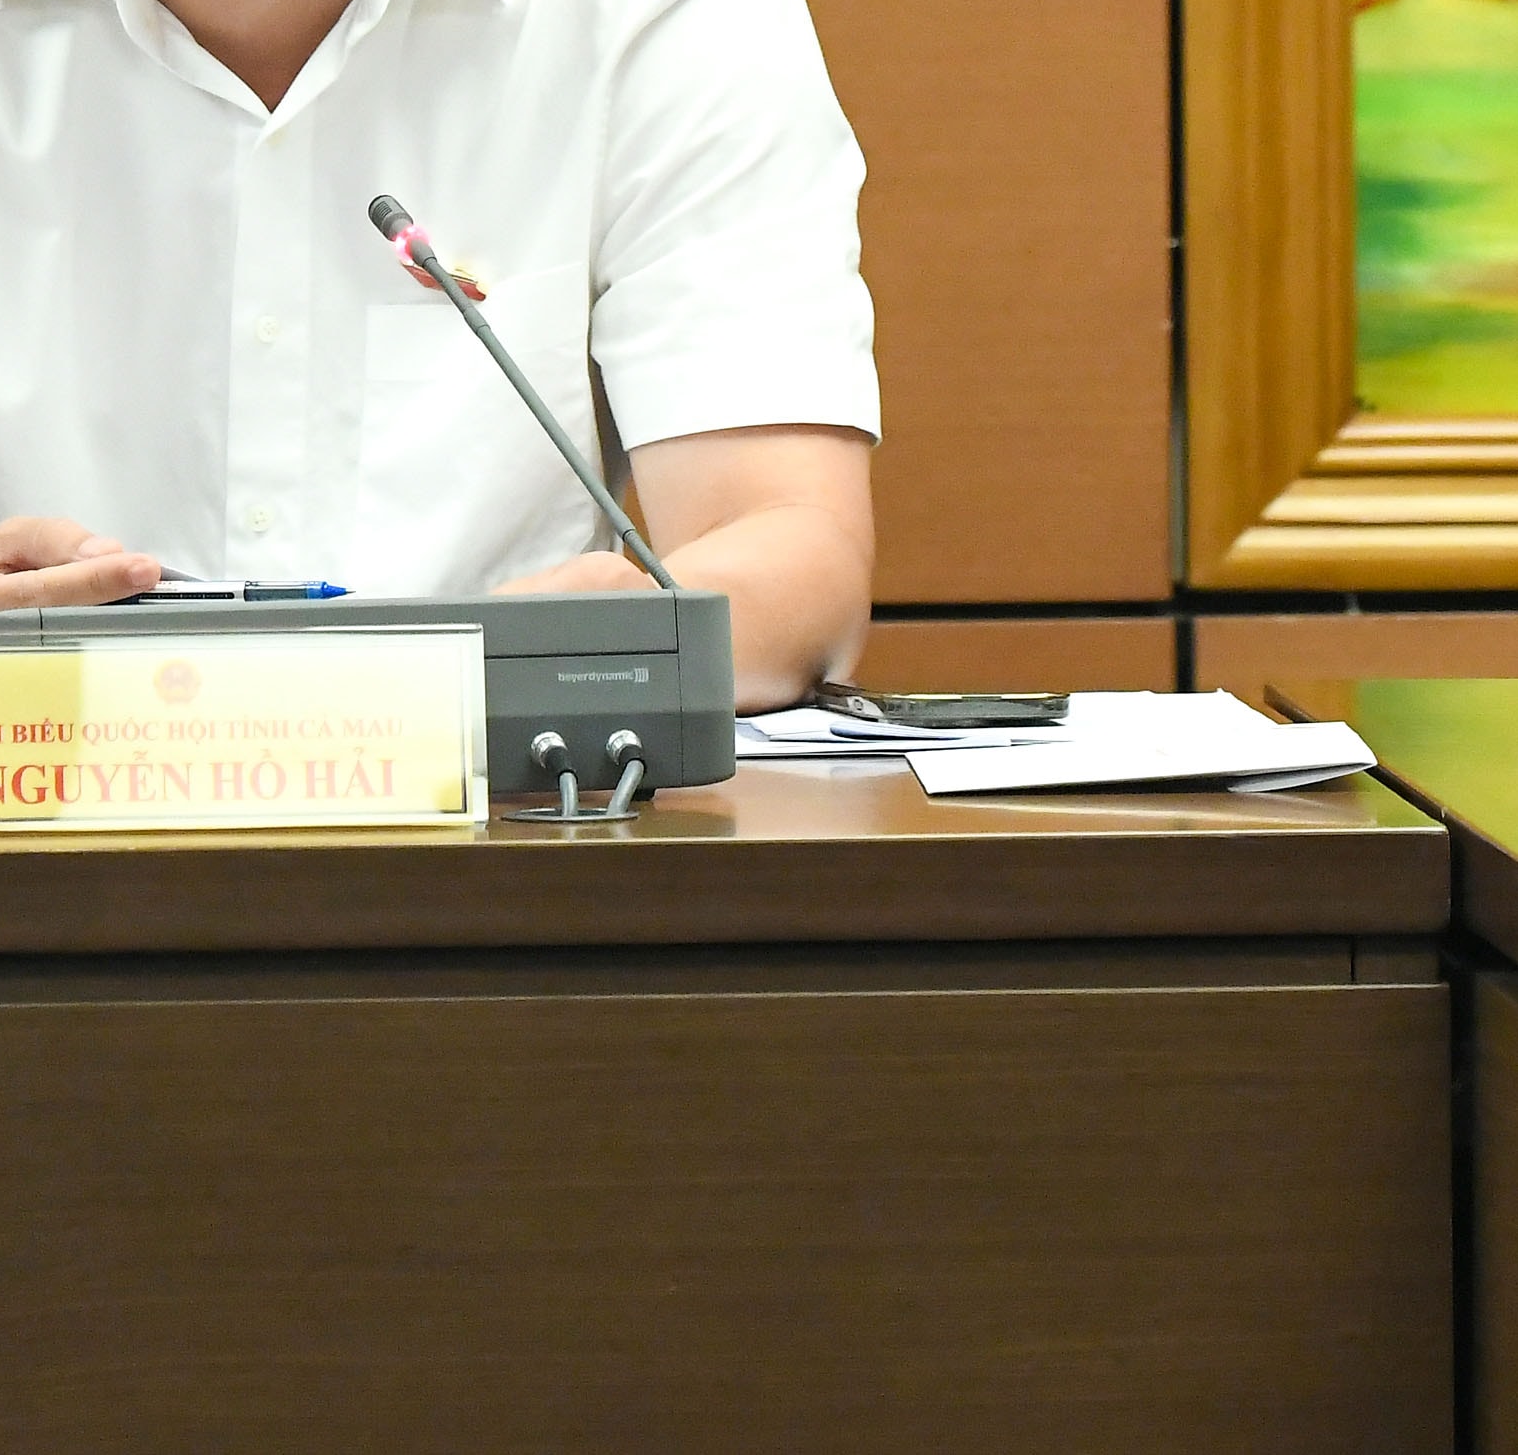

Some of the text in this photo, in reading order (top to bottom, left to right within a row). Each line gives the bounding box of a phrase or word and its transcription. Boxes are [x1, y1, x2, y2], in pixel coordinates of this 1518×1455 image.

[12, 718, 74, 743] BIỂU
[82, 717, 160, 746] QUỐC
[168, 718, 216, 746] HỘI
[341, 718, 404, 738] MAU
[303, 747, 396, 799] HẢI
